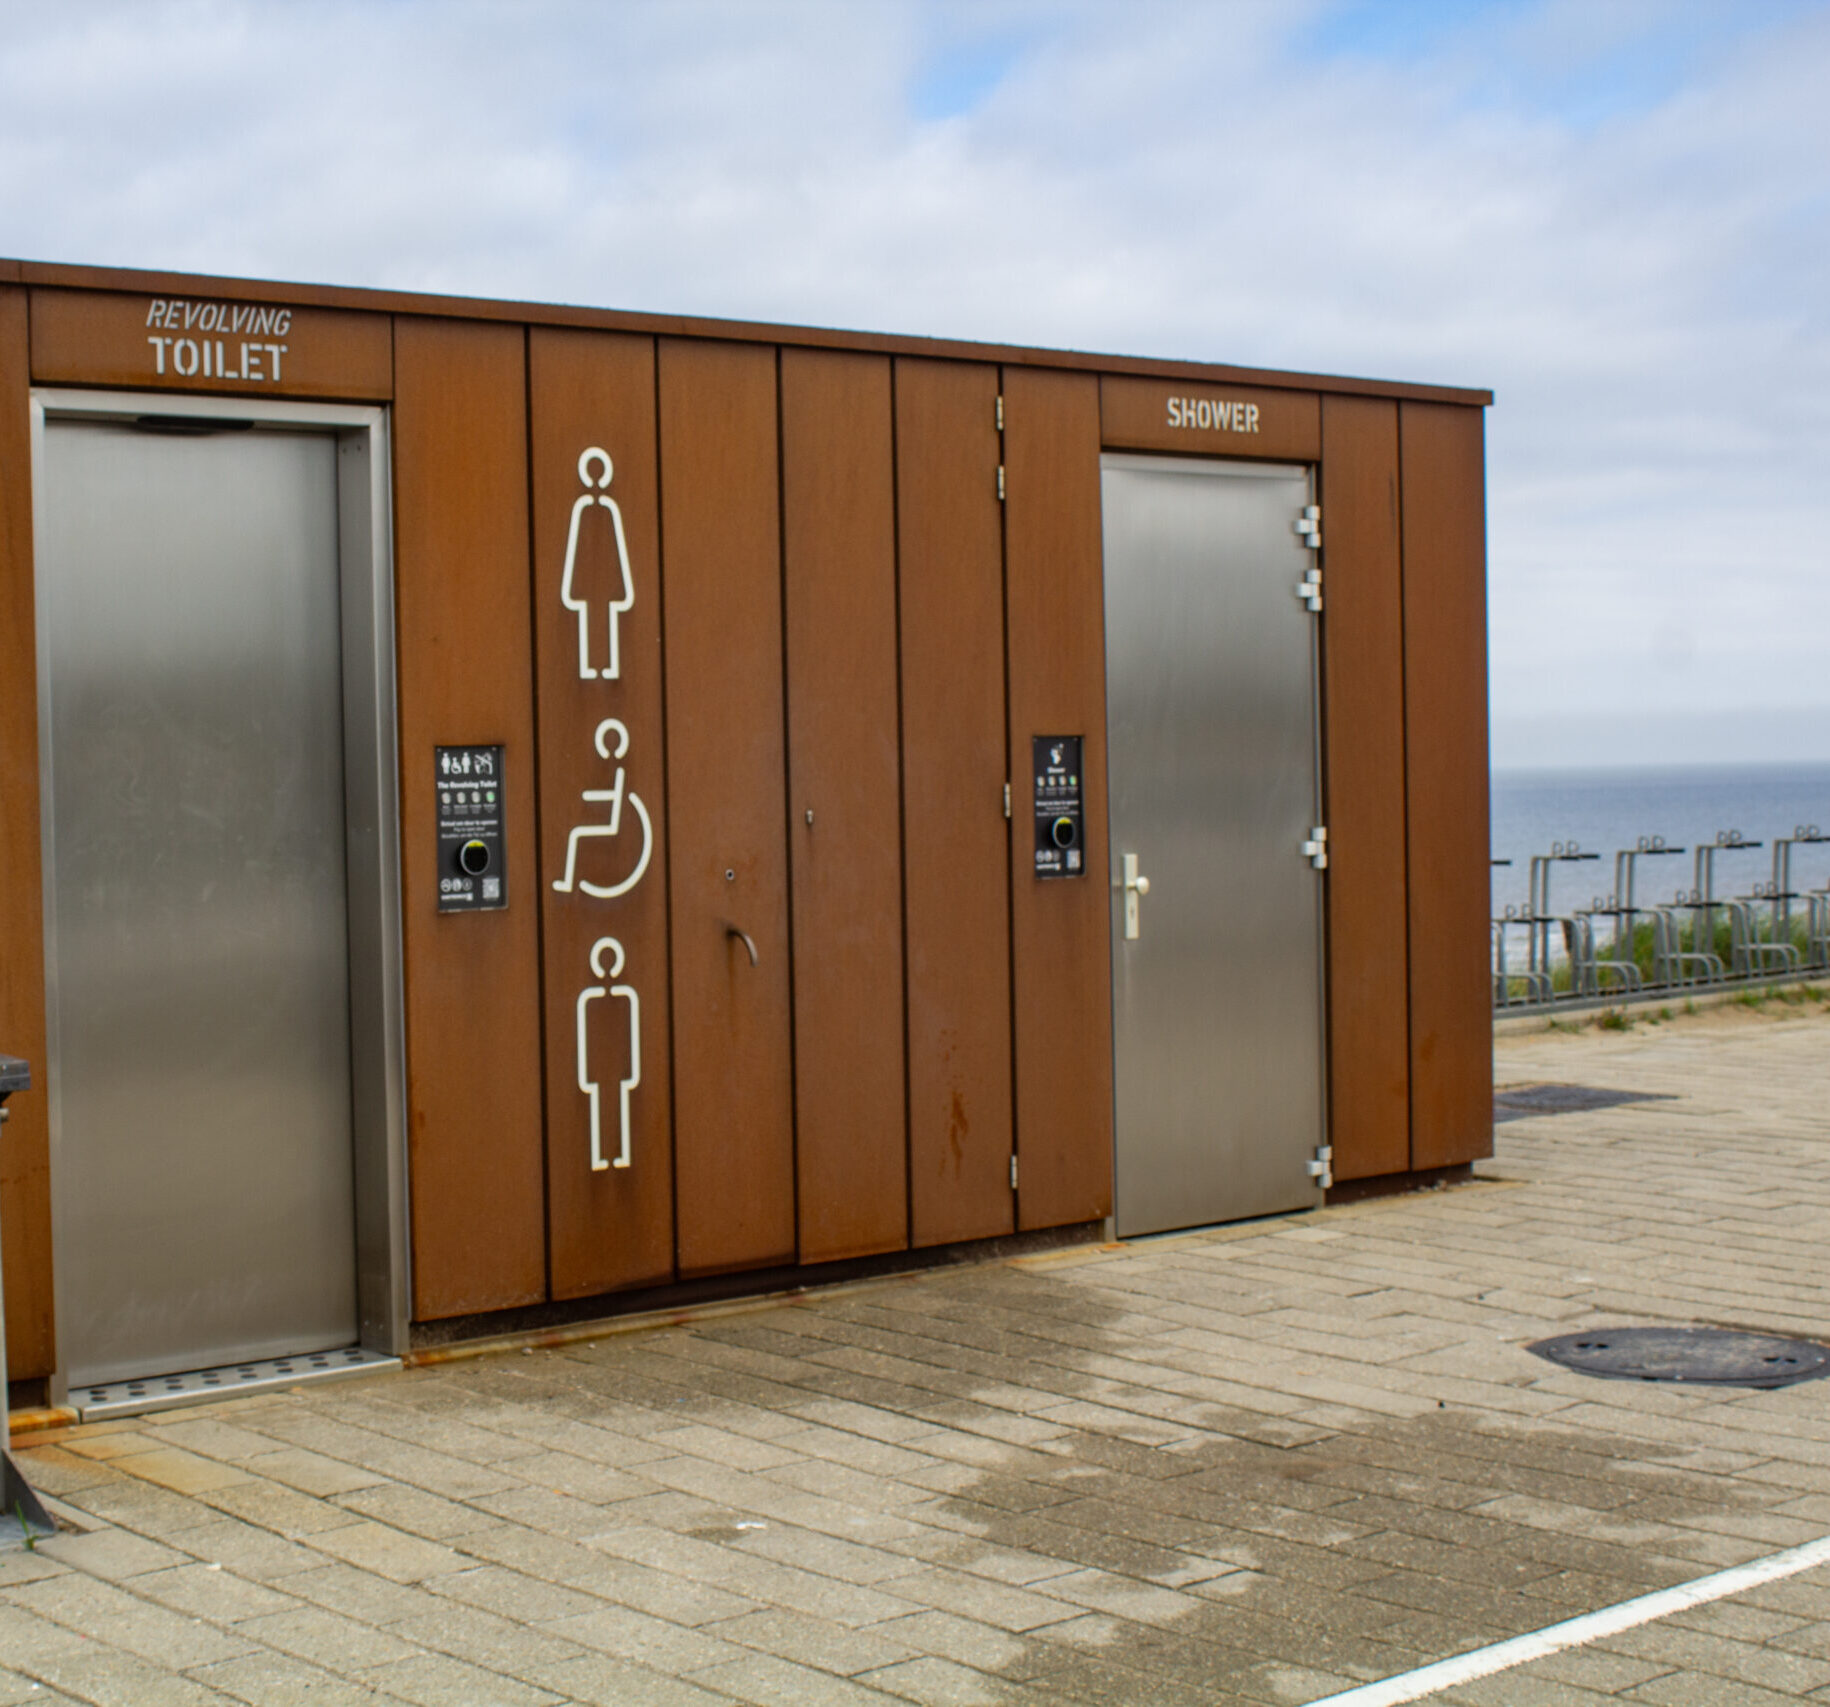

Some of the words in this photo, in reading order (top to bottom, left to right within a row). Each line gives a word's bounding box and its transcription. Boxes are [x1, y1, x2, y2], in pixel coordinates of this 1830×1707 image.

[145, 299, 292, 336] REVOLVING
[147, 336, 288, 381] TOILET
[1167, 397, 1259, 433] SHOWER
